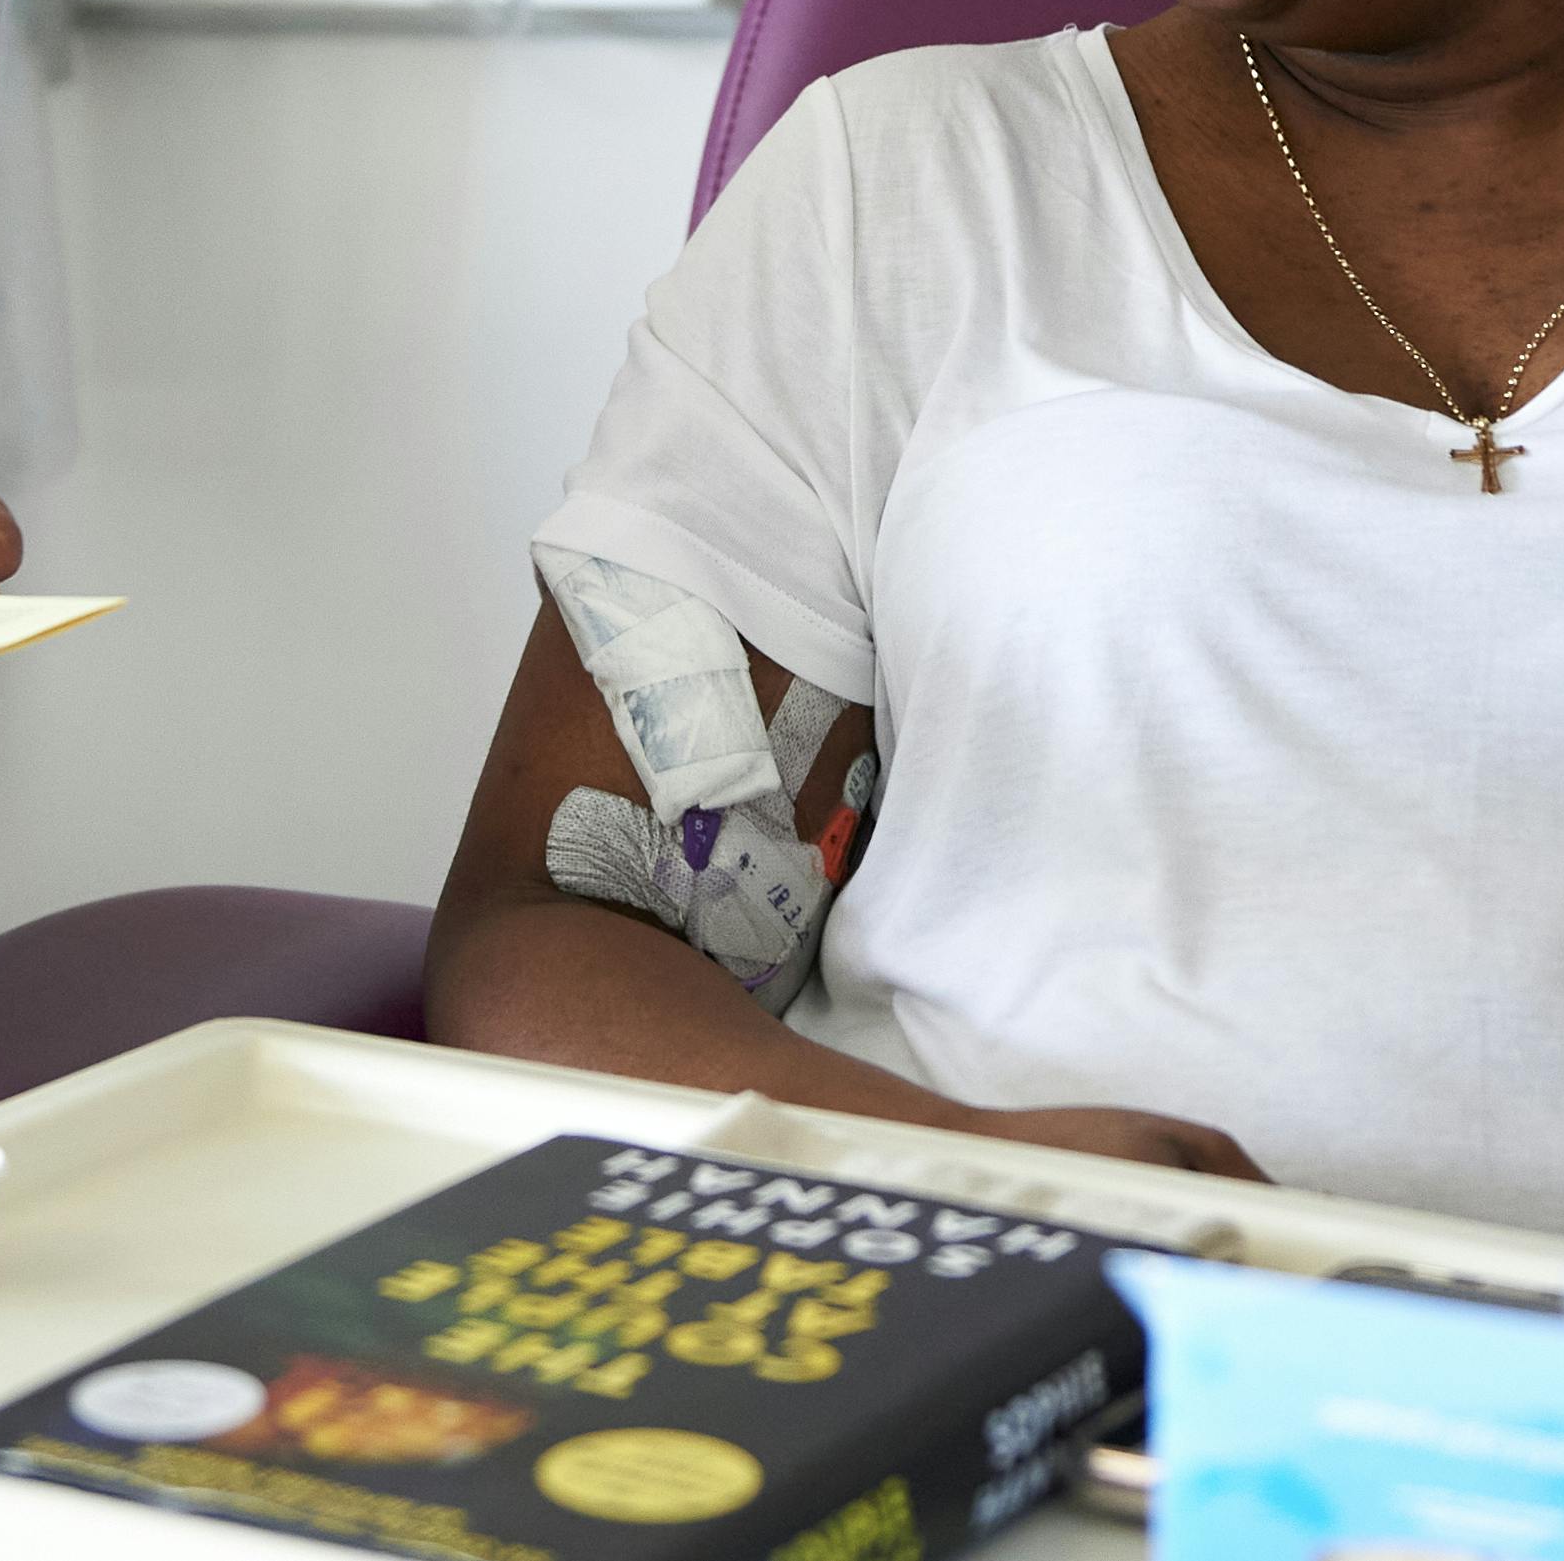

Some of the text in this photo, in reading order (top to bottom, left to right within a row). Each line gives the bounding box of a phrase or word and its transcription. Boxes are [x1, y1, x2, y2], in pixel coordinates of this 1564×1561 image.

[587, 1177, 995, 1280] SOPHIE
[597, 1146, 1081, 1263] HANNAH
[466, 1237, 685, 1309] THE
[552, 1214, 894, 1308] TABLE
[377, 1258, 844, 1384] COUPLE
[423, 1317, 654, 1401] THE
